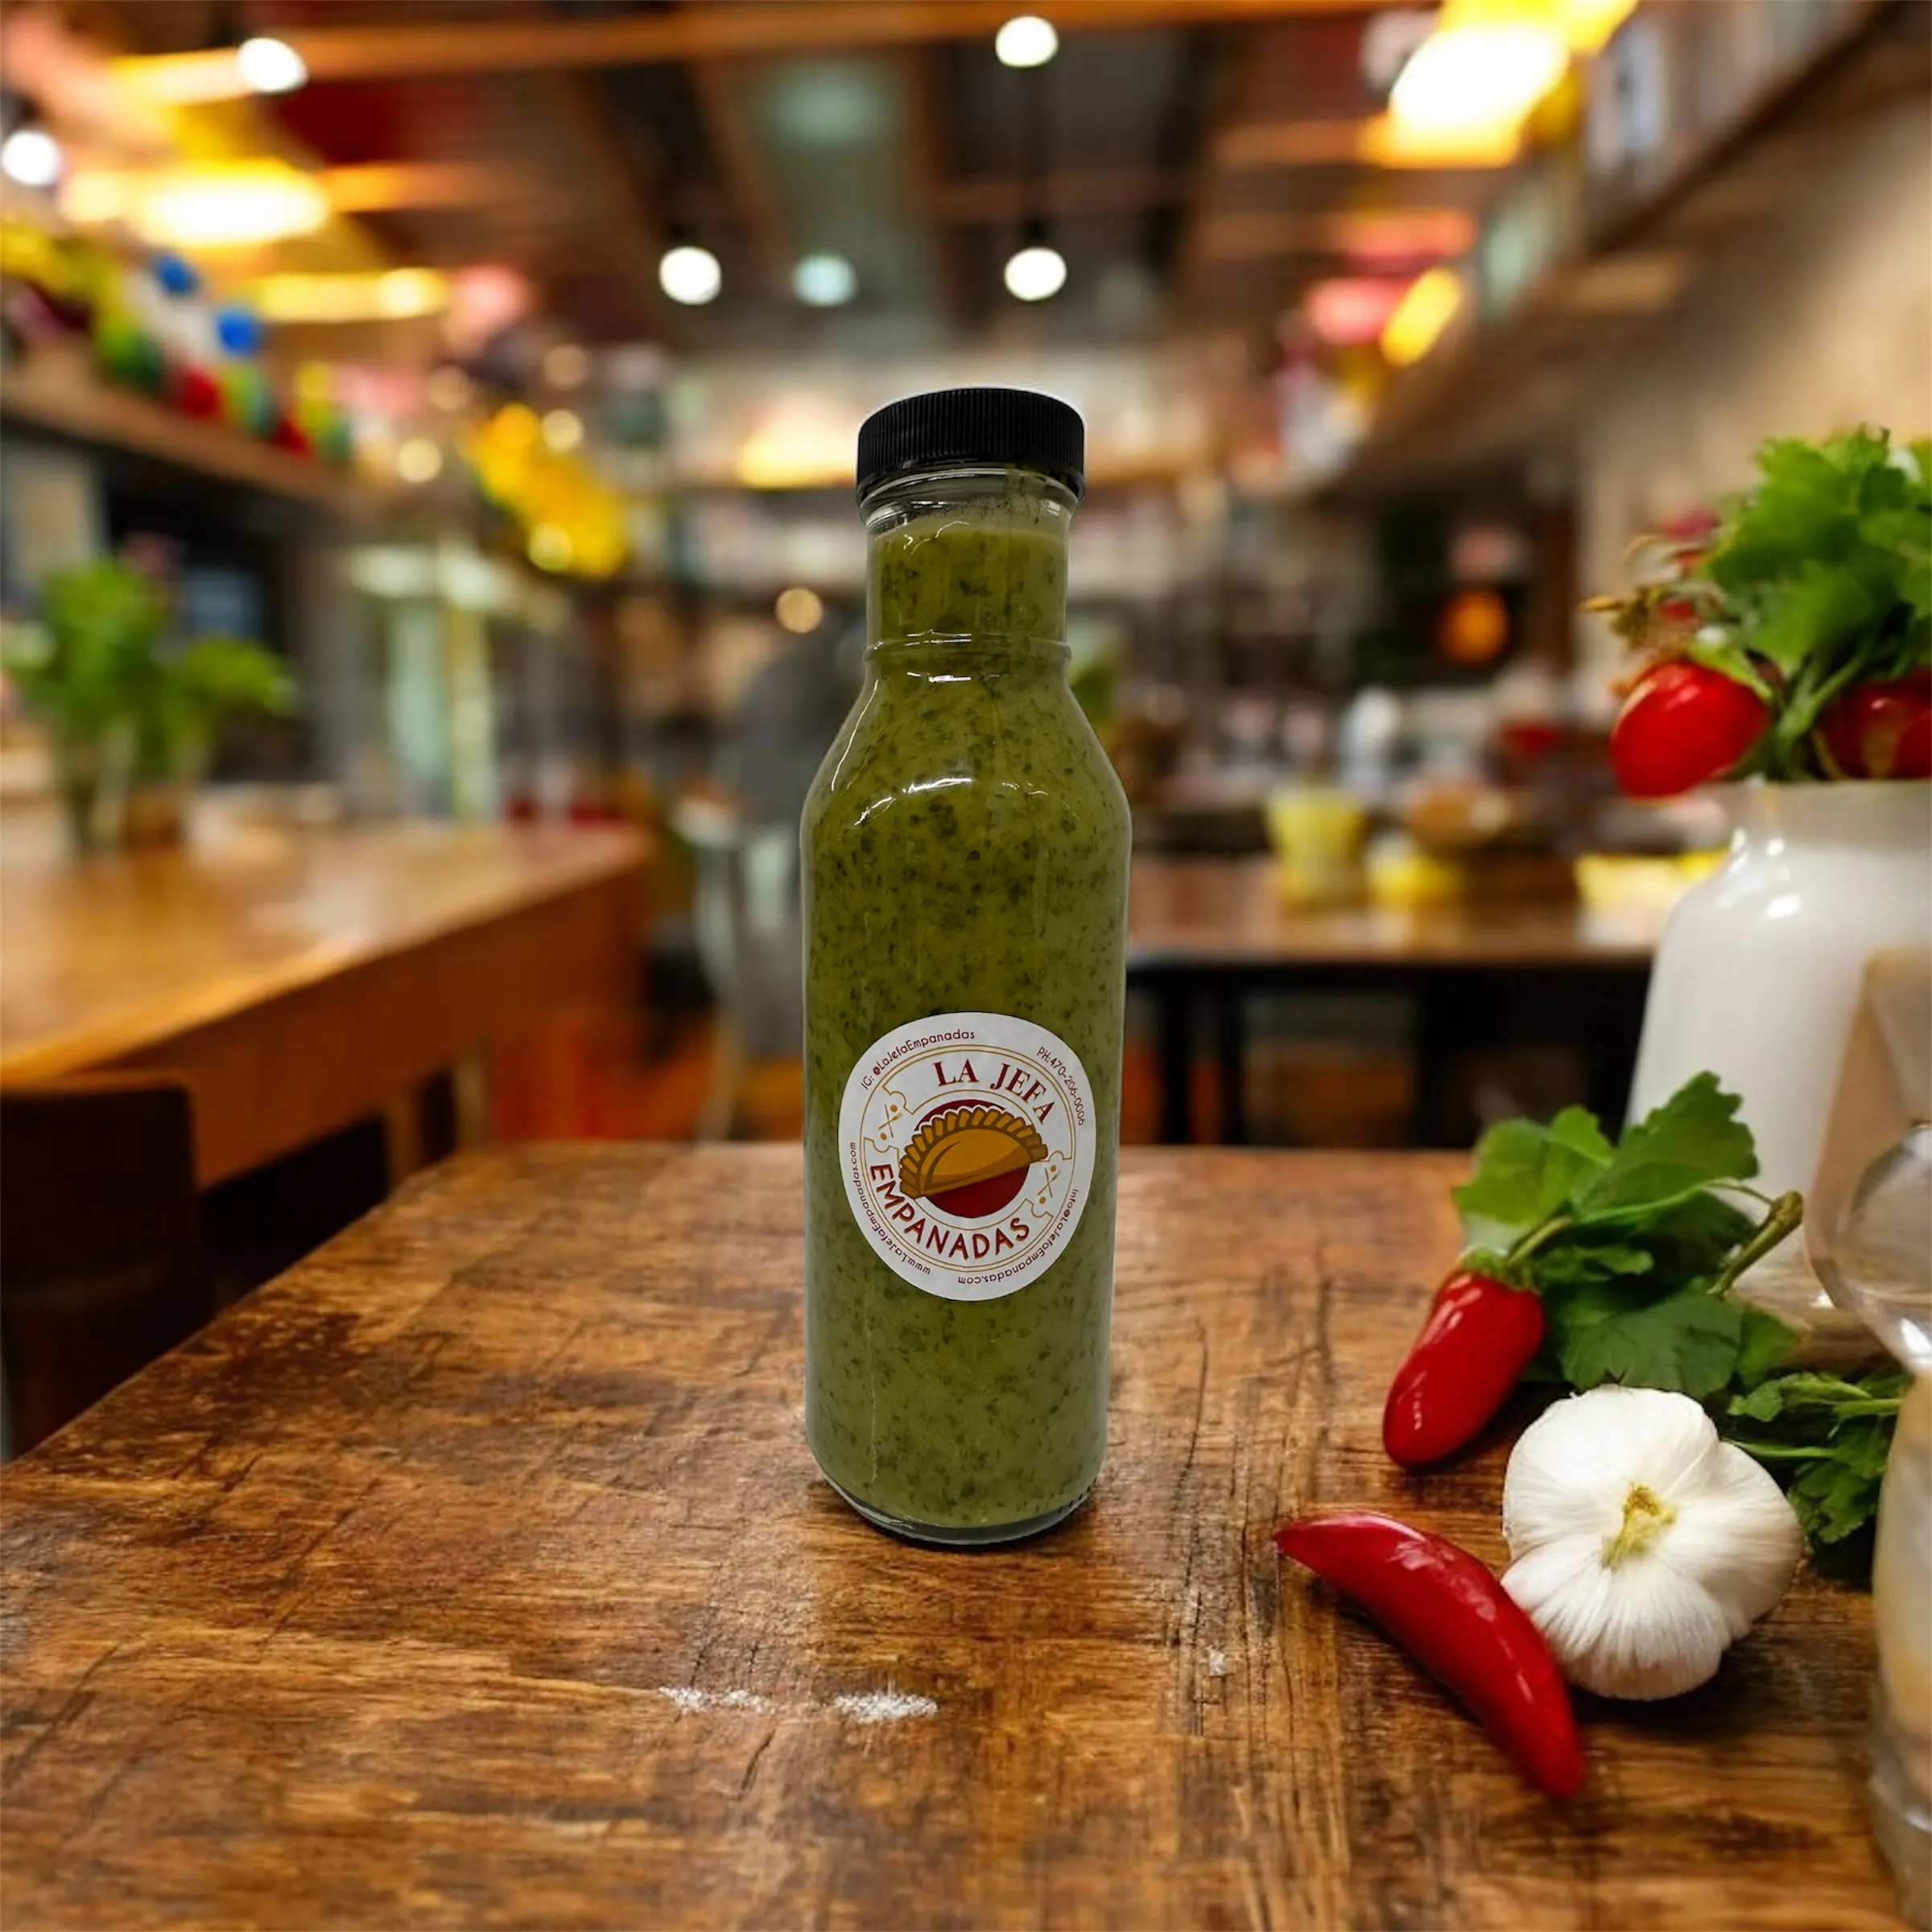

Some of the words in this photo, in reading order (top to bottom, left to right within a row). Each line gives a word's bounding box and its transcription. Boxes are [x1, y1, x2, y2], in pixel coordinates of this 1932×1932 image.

[873, 1029, 975, 1075] @LaJefaEmpanadas
[932, 1058, 980, 1087] LA
[989, 1063, 1055, 1125] JEFA
[849, 1141, 931, 1275] www.LaJefaEmpanadas.com
[870, 1164, 1030, 1260] EMPANADAS
